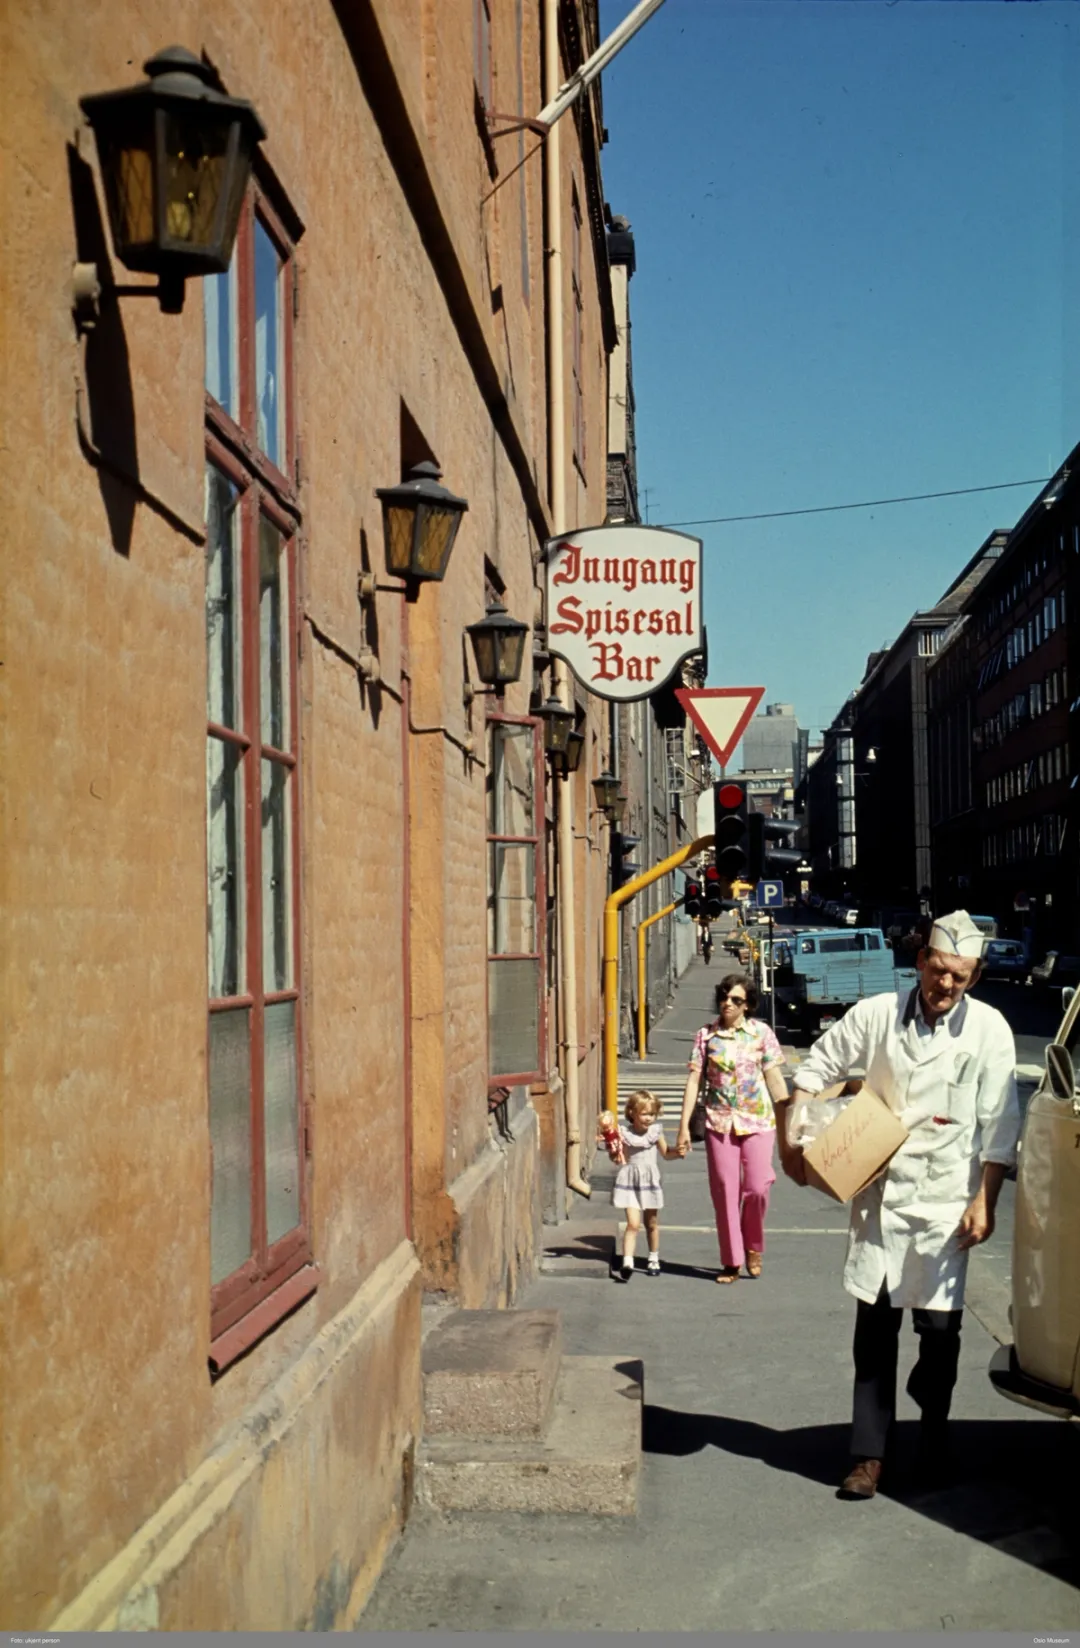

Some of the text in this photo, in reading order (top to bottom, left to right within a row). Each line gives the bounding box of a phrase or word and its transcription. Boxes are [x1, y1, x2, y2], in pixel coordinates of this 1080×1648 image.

[553, 542, 696, 593] Inngang
[549, 595, 694, 641] Spisesal
[588, 642, 661, 682] Bar
[764, 884, 778, 905] P
